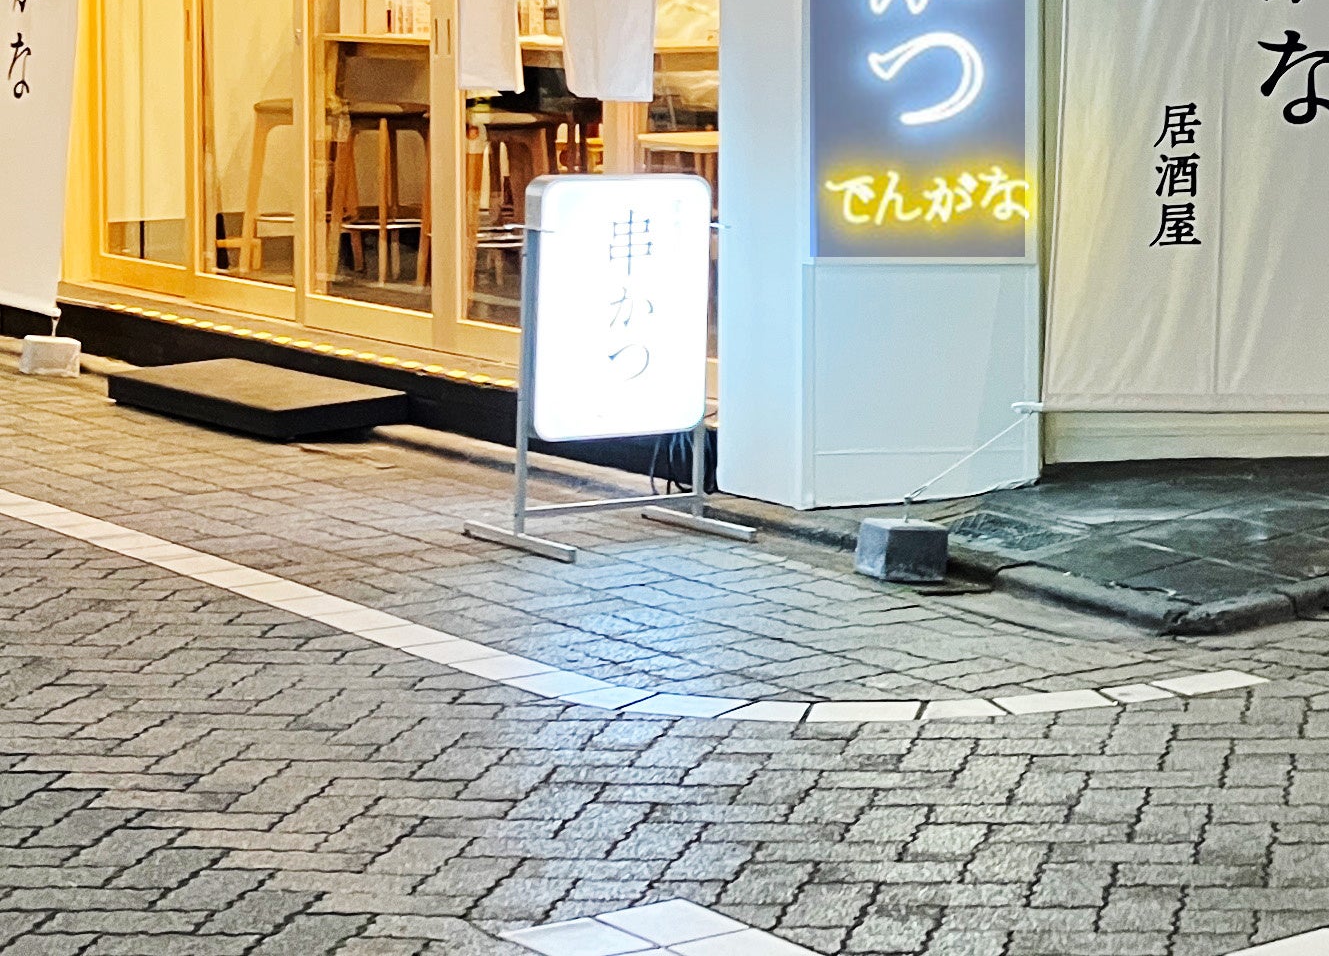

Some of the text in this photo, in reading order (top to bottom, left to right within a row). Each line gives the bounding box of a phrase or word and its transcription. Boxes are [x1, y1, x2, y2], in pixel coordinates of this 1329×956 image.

[824, 164, 1032, 224] でんがな
[1148, 101, 1203, 248] 居酒屋
[607, 209, 654, 383] 串かつ
